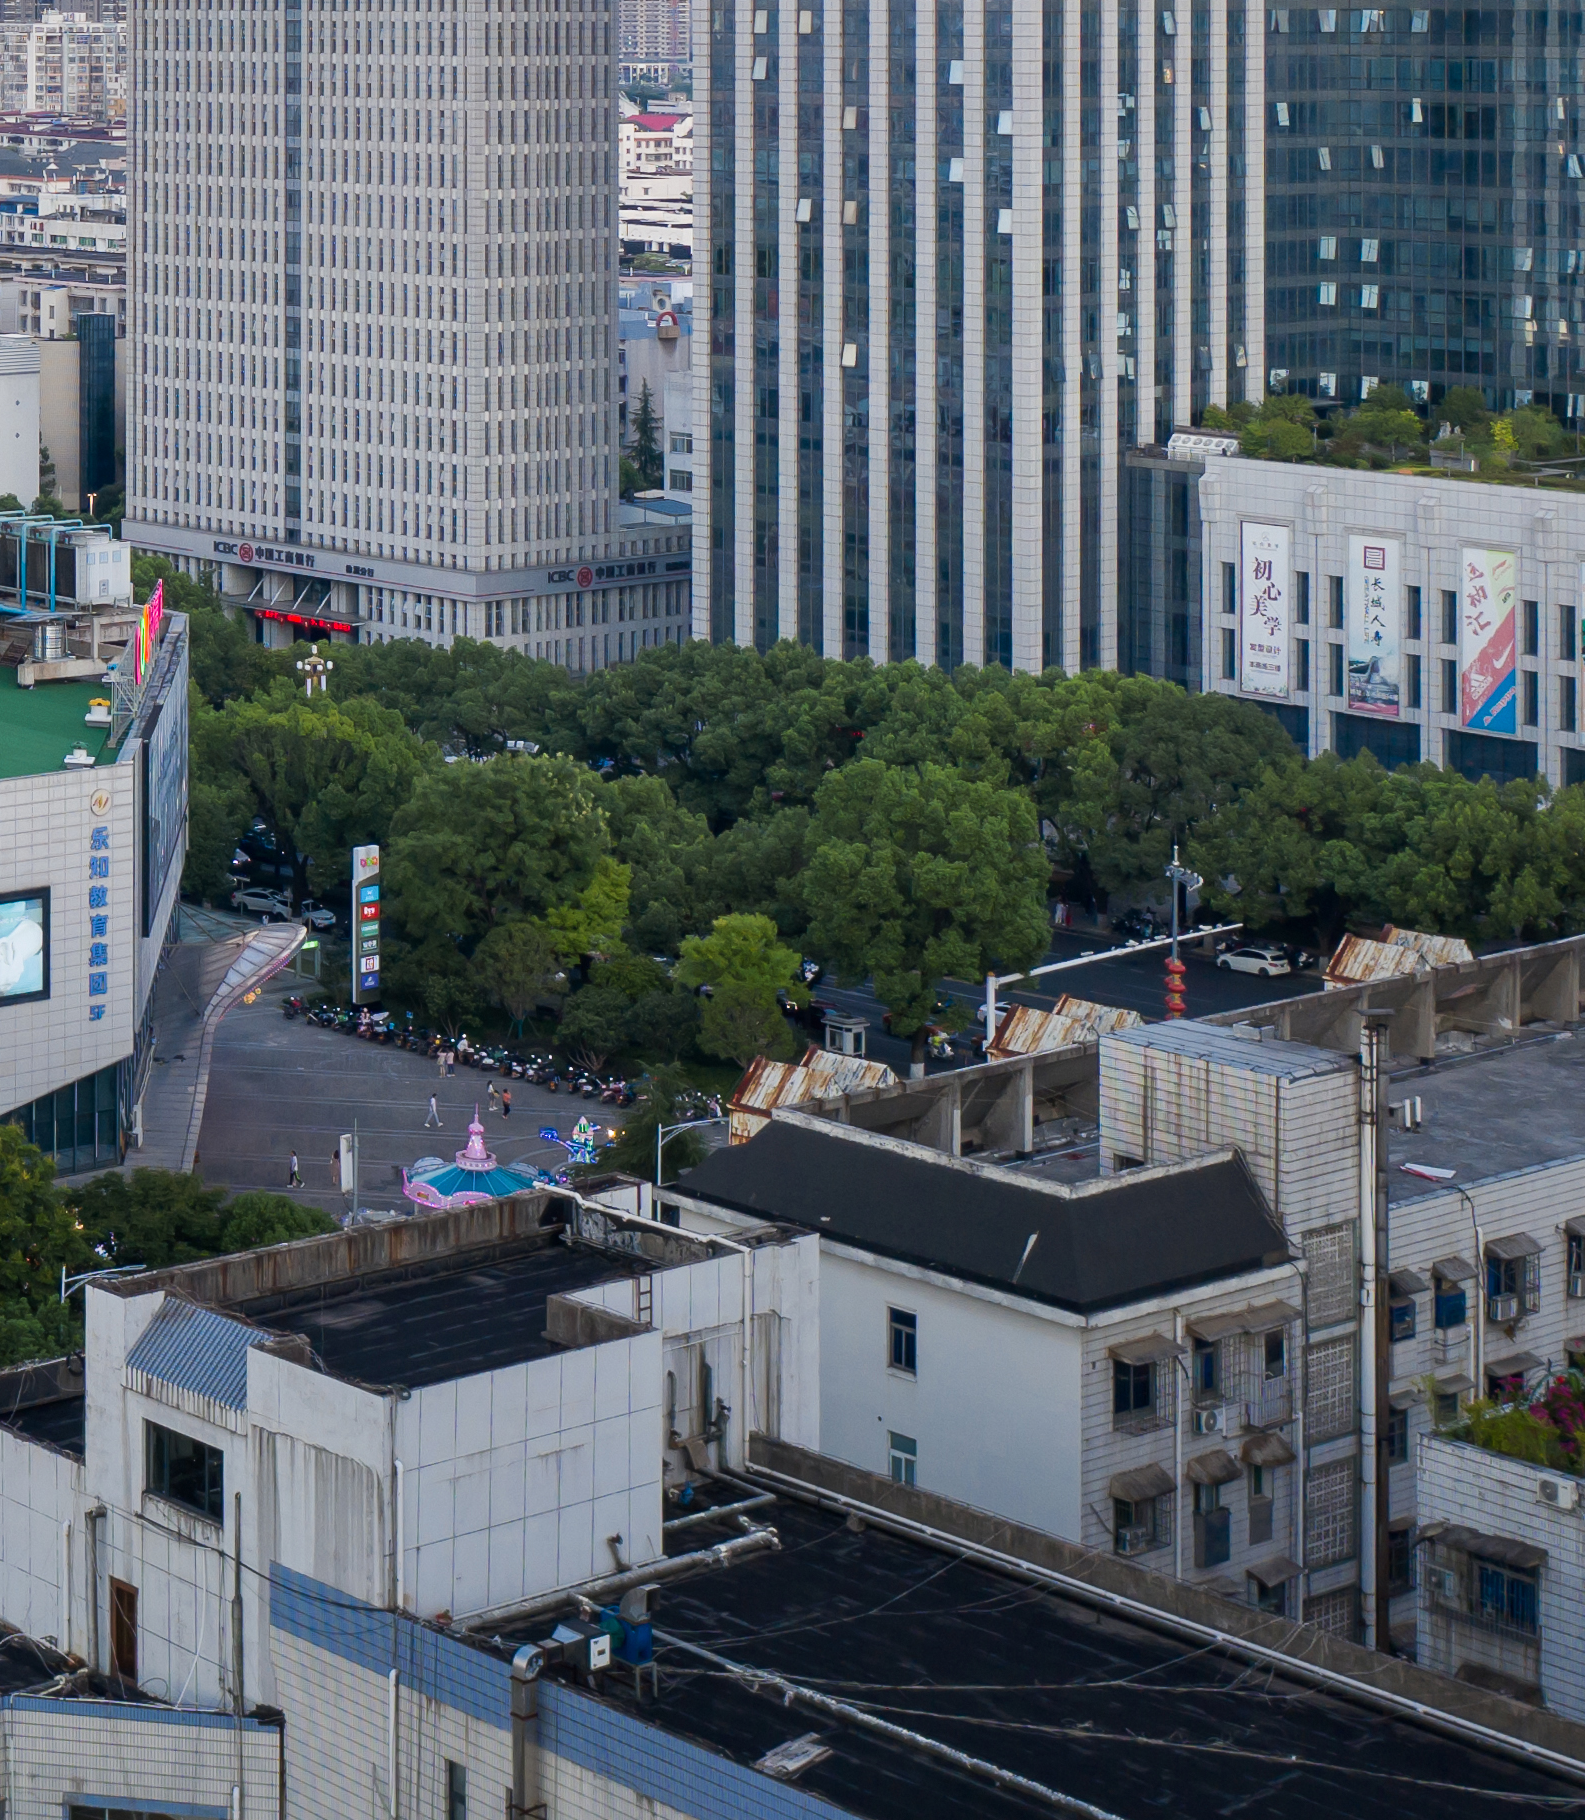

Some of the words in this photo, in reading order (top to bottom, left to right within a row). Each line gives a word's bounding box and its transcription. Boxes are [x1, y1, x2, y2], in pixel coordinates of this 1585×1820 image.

[213, 540, 238, 556] ICBC
[255, 545, 315, 567] 中国工商银行
[547, 569, 575, 584] ICBC
[1370, 576, 1386, 647] 长城人寿
[89, 826, 110, 996] 乐知教育集团
